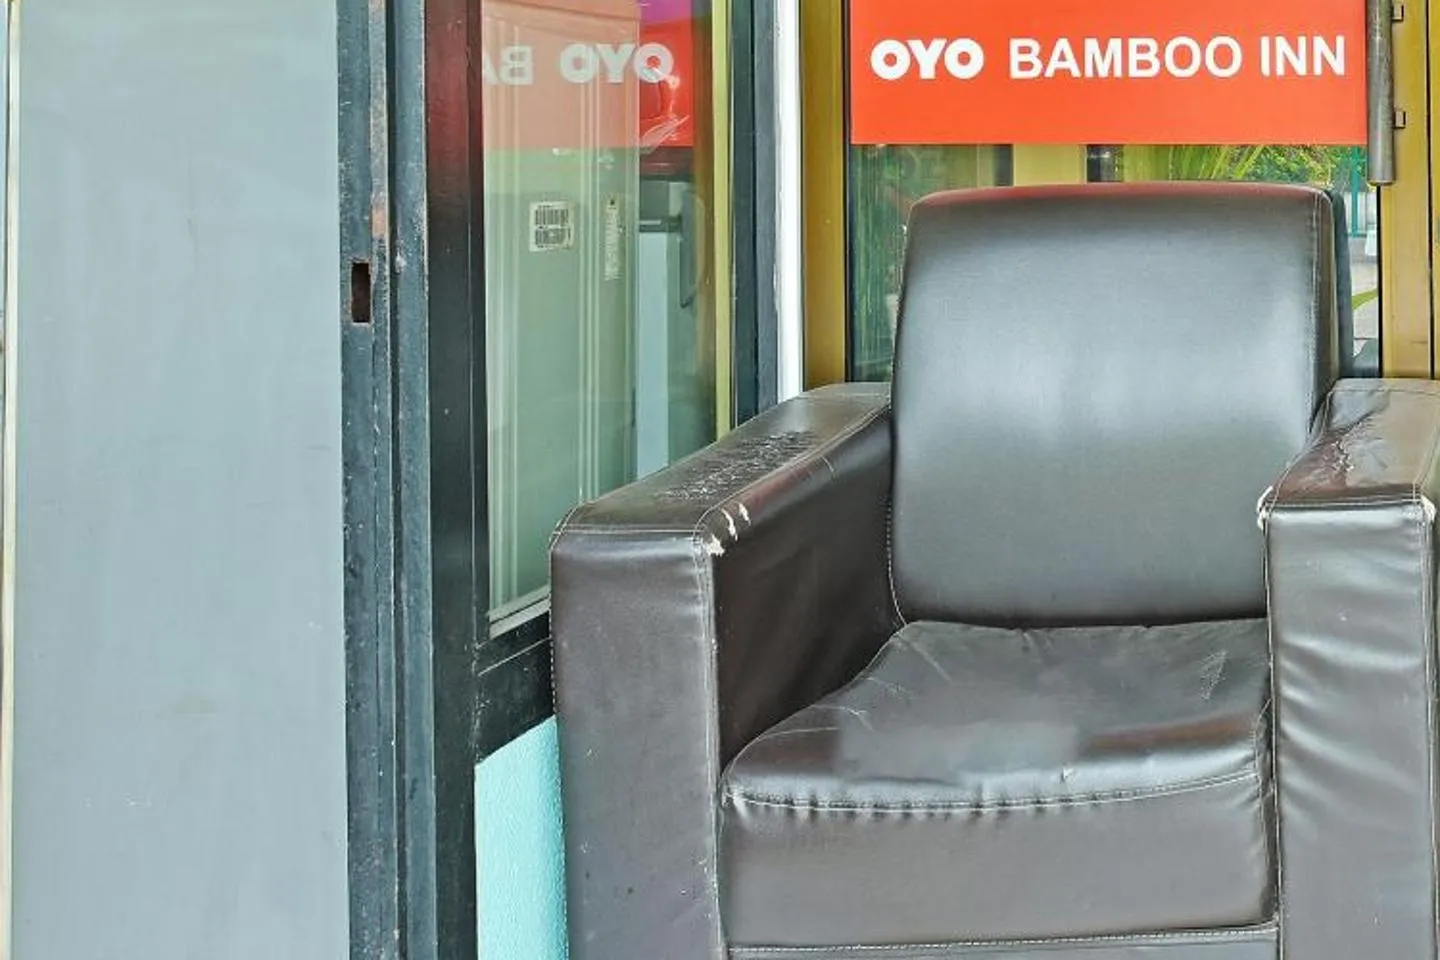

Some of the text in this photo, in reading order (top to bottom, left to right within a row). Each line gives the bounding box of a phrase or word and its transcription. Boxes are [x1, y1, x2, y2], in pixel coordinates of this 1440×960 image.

[870, 35, 1346, 80] OYO BAMBOO INN
